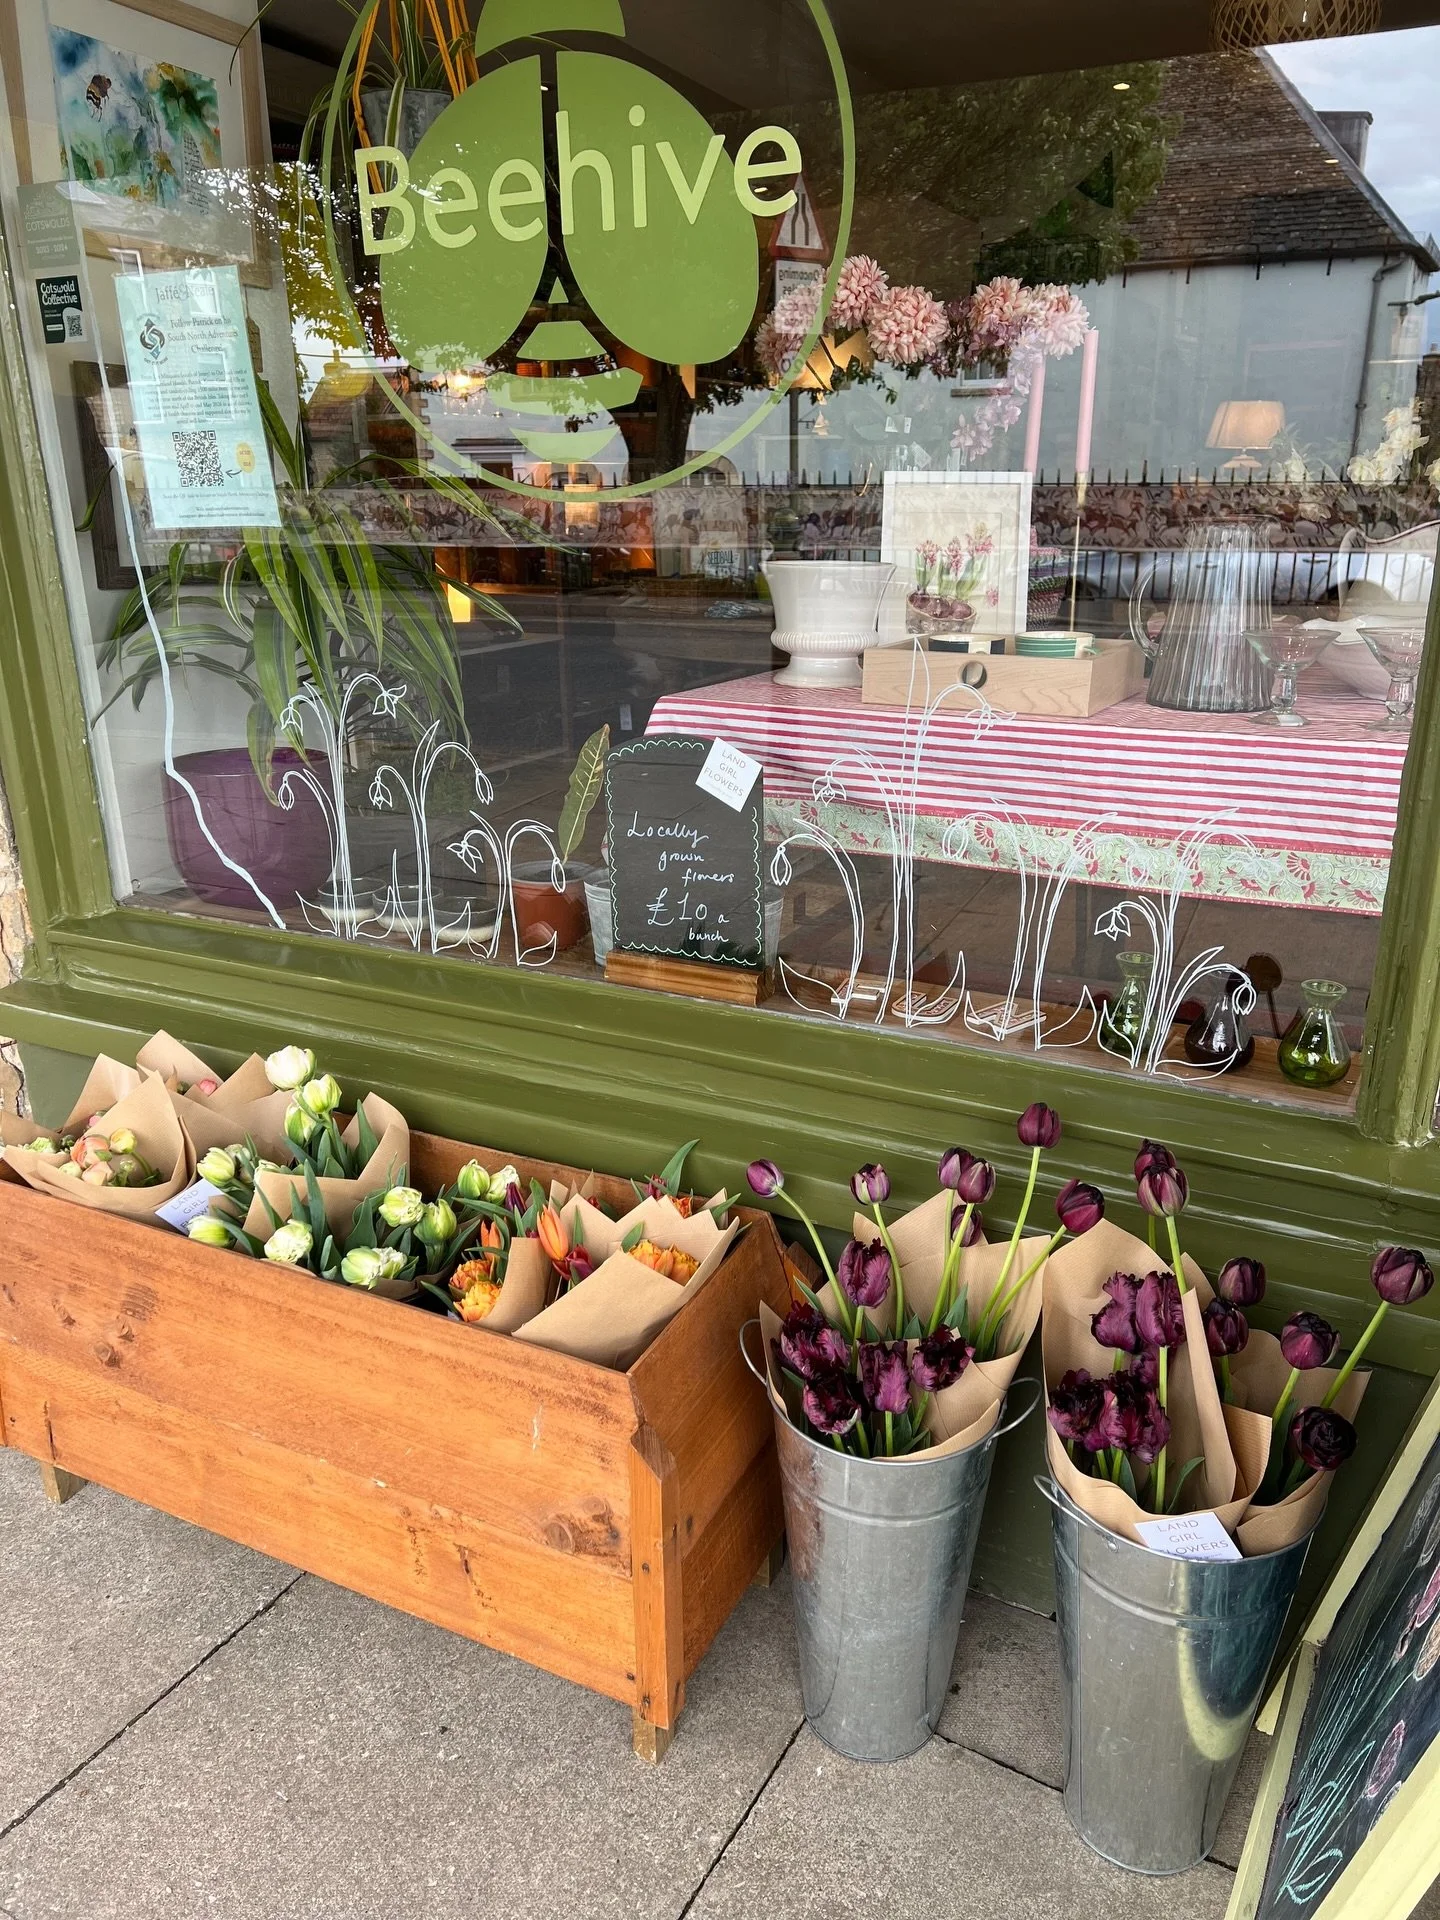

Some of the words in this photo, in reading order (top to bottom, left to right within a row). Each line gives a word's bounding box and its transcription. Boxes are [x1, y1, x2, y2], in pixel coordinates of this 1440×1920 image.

[355, 105, 802, 255] Beehive
[40, 280, 76, 294] Cotswold
[42, 293, 78, 306] Collective
[170, 317, 191, 329] Follow
[192, 316, 214, 326] Patrick
[168, 332, 186, 341] South
[187, 331, 206, 341] North
[721, 749, 746, 768] LAND
[719, 763, 737, 780] GIRL
[703, 766, 744, 796] FLOWERS
[627, 811, 709, 848] Locally
[658, 851, 705, 871] grown
[681, 868, 735, 887] flowers
[646, 887, 708, 926] £10
[718, 914, 730, 923] a
[688, 927, 730, 942] bunch
[171, 1189, 199, 1210] LAND
[183, 1200, 206, 1215] GIRL
[1157, 1519, 1199, 1533] LAND
[1169, 1532, 1204, 1543] GIRL
